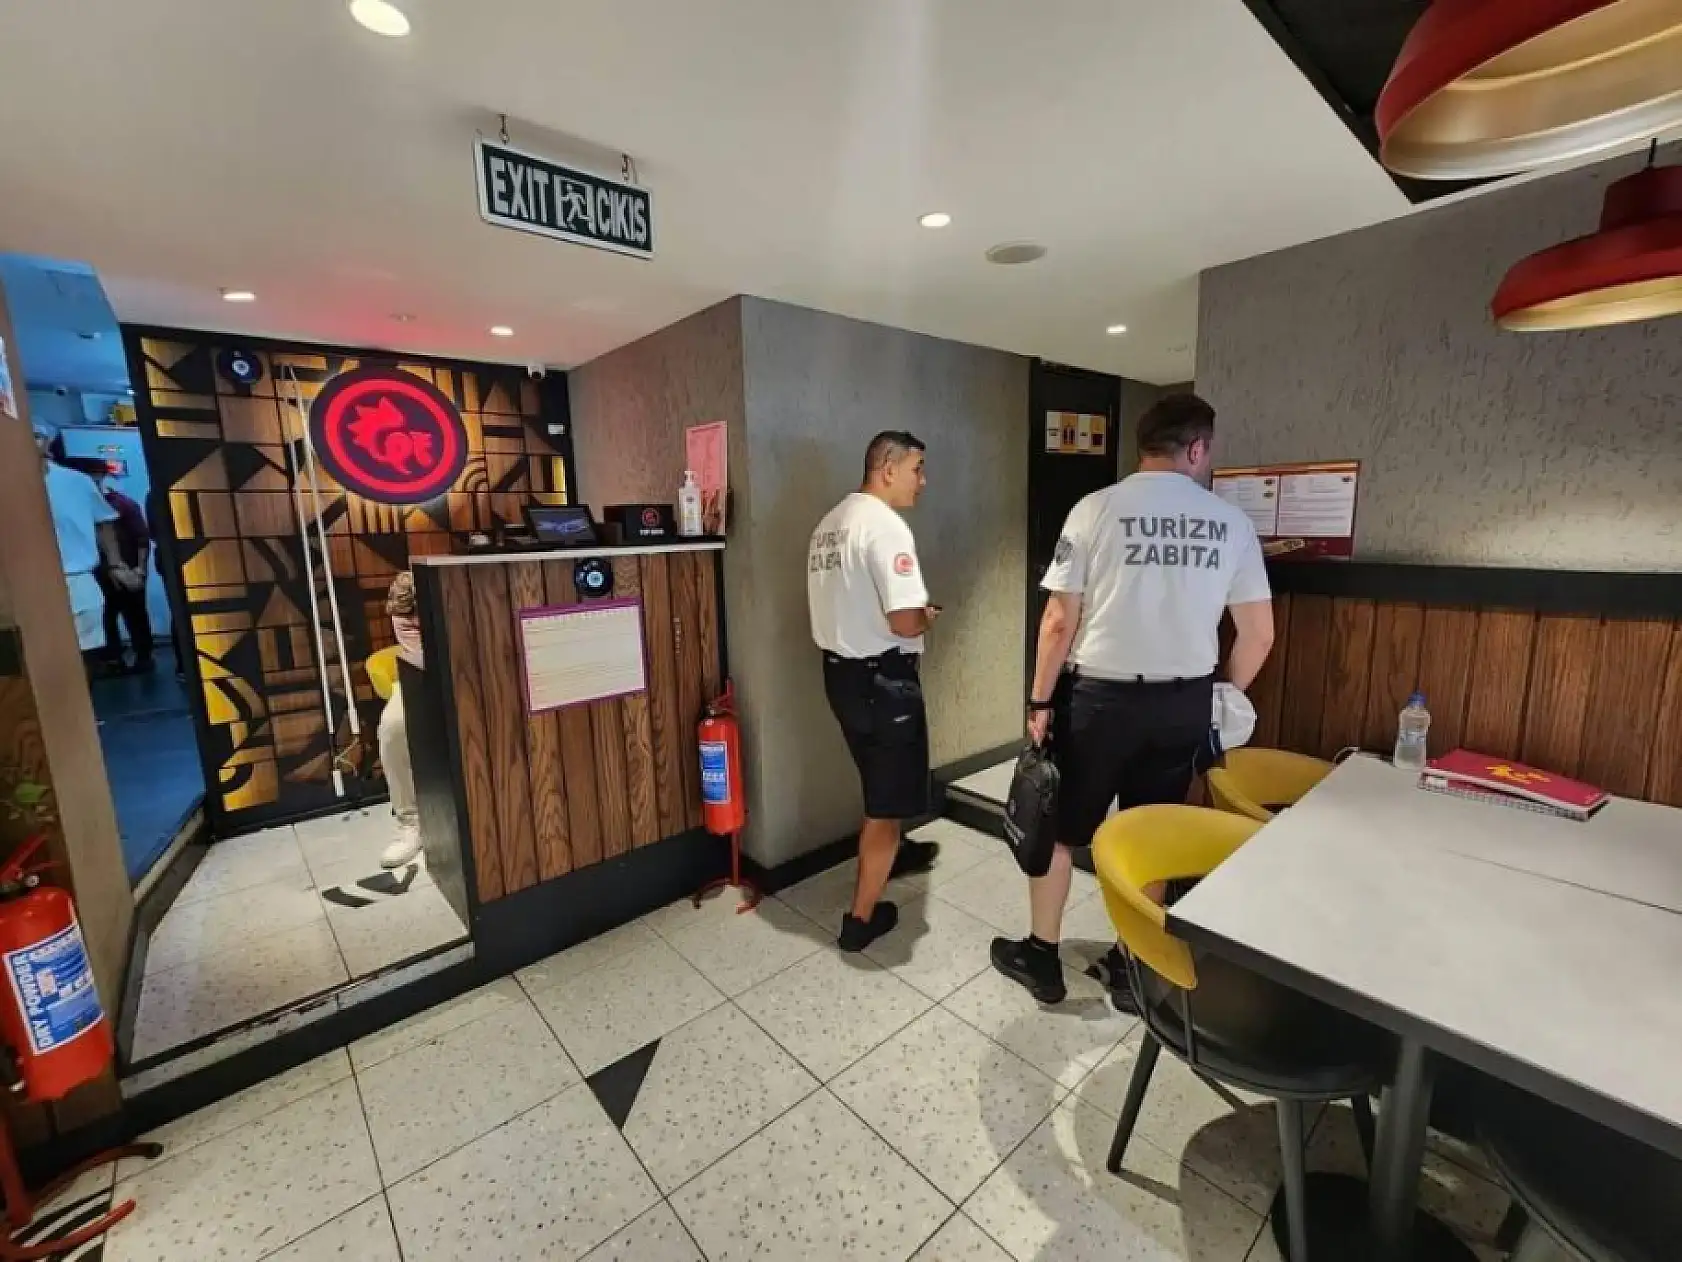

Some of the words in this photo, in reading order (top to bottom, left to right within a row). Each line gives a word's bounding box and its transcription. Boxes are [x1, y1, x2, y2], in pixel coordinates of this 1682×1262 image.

[489, 156, 549, 223] EXIT
[1119, 512, 1228, 543] TURİZM
[1125, 544, 1220, 570] ZABITA
